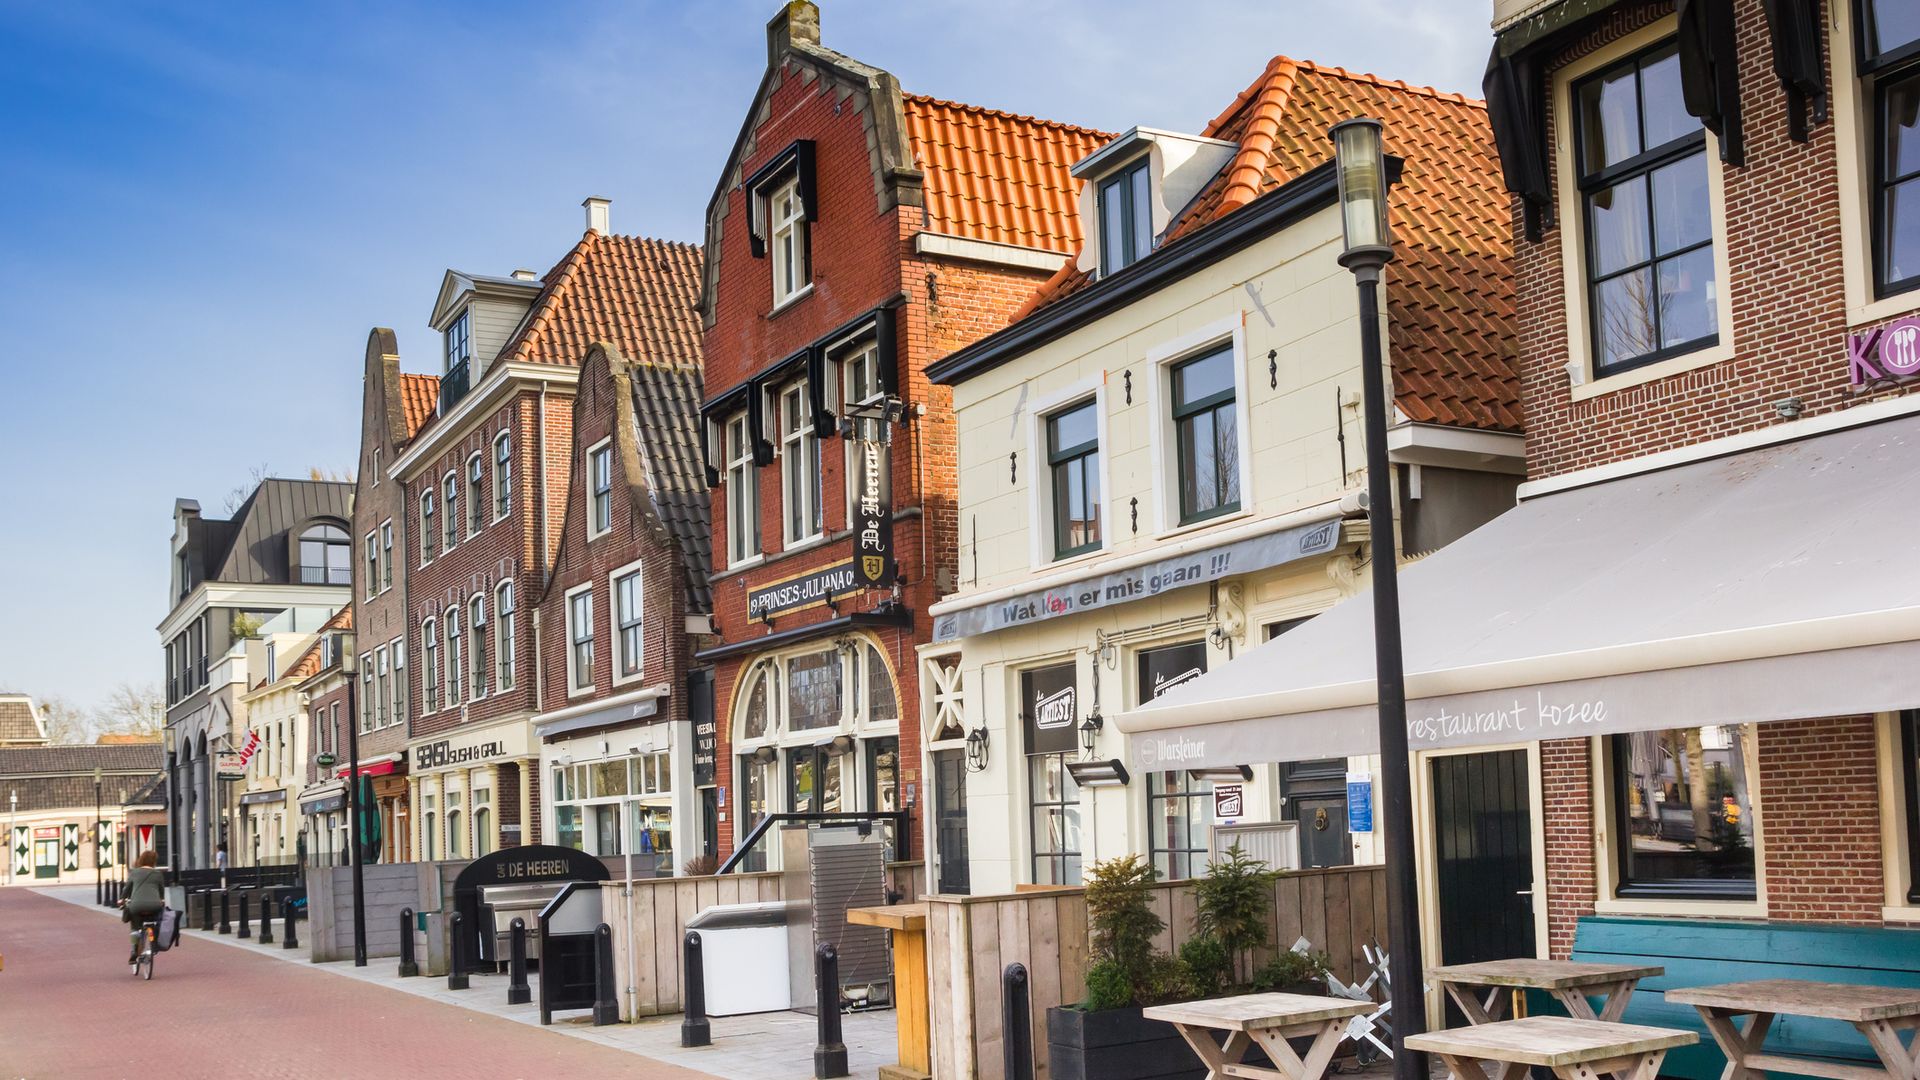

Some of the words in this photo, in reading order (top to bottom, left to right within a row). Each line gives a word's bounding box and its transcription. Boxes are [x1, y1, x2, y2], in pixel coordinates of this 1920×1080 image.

[862, 441, 885, 517] Heeren
[862, 520, 885, 552] De
[1303, 526, 1330, 549] ARTIEST
[1003, 602, 1036, 623] Wat
[1079, 588, 1101, 606] er
[1106, 578, 1144, 601] mis
[1150, 563, 1201, 594] gaan
[1210, 552, 1231, 575] !!!
[750, 598, 758, 614] 19
[1040, 694, 1071, 724] ARTIEST
[1406, 700, 1527, 740] restaurant
[1537, 691, 1609, 728] kozee
[416, 740, 449, 770] SENSO
[449, 746, 472, 763] SUSHI
[473, 745, 479, 760] &
[481, 740, 507, 758] GRILL
[1157, 735, 1205, 762] Warsteiner
[509, 862, 524, 877] DE
[527, 859, 569, 876] HEEREN
